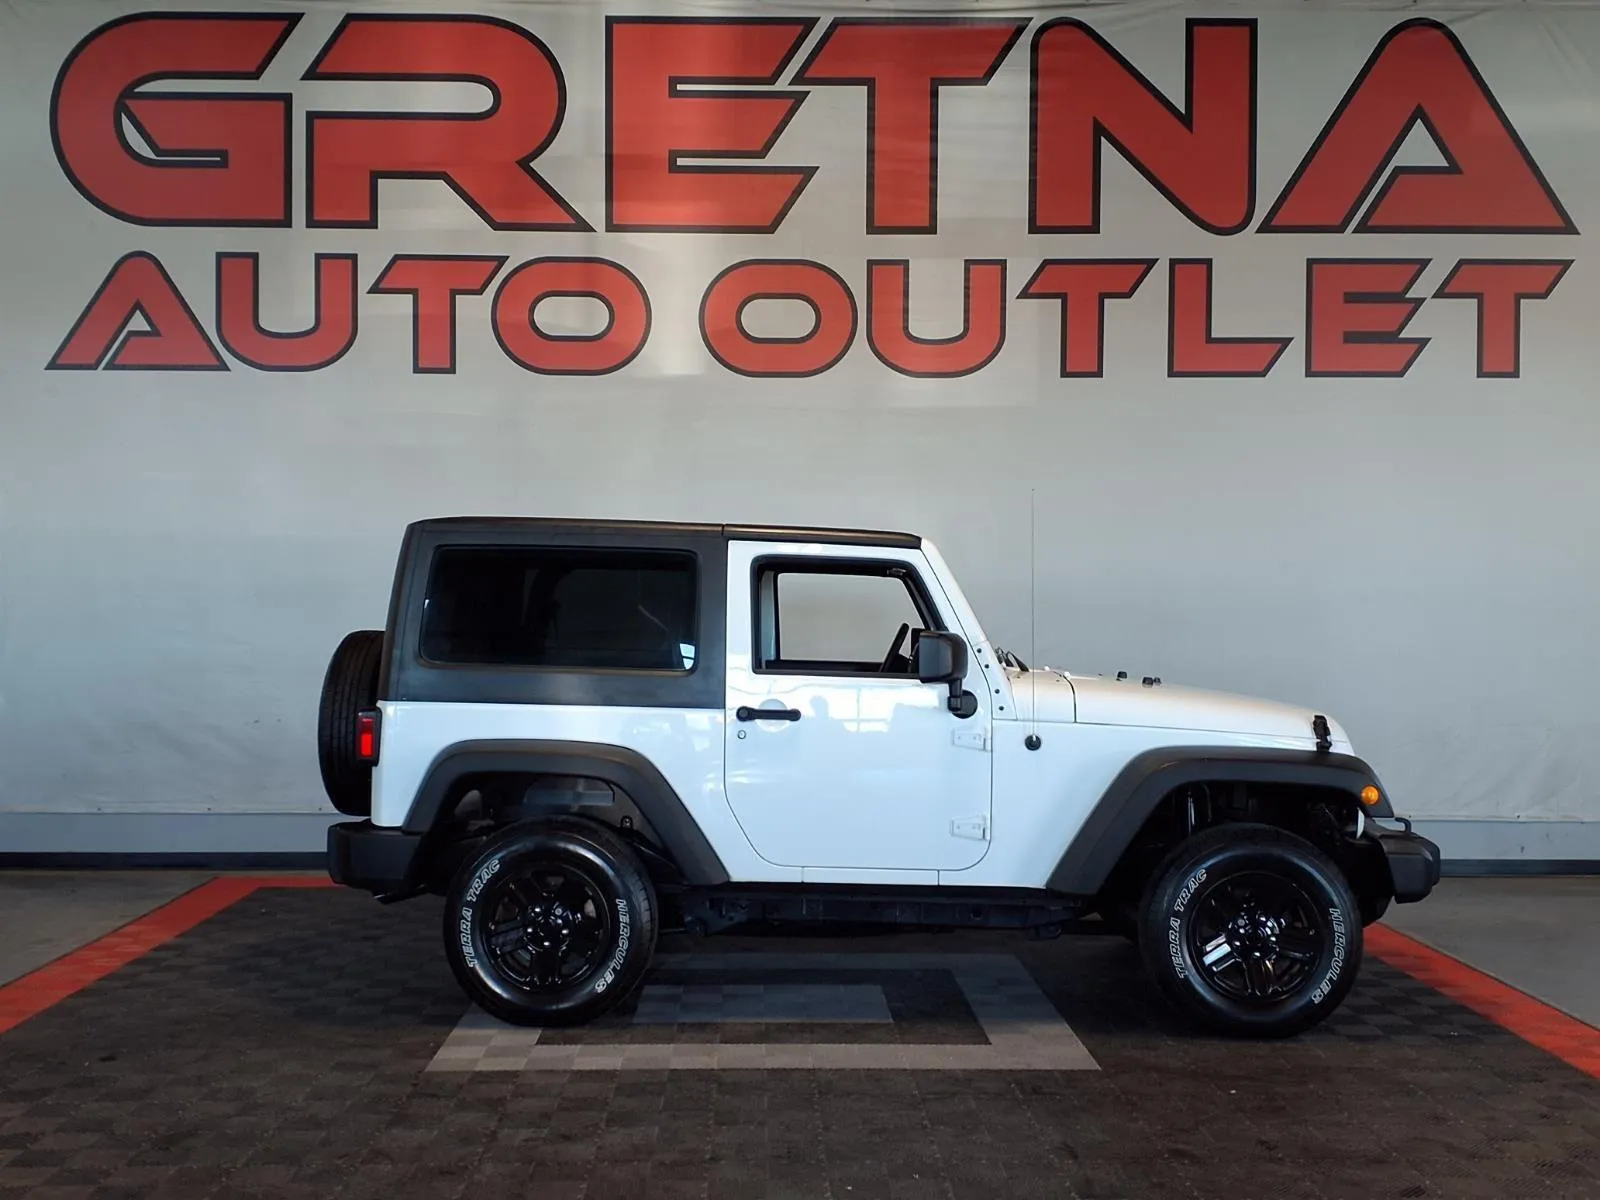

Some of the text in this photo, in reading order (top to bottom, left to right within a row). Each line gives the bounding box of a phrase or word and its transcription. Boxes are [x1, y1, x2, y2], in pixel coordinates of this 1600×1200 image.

[49, 11, 1581, 236] GRETNA
[44, 250, 1576, 379] AUTO OUTLET
[460, 859, 500, 968] TERRA TRAC
[594, 898, 631, 994] HERCULES
[1169, 868, 1207, 979] TERRA TRAC
[1311, 907, 1346, 1005] HERCULES
